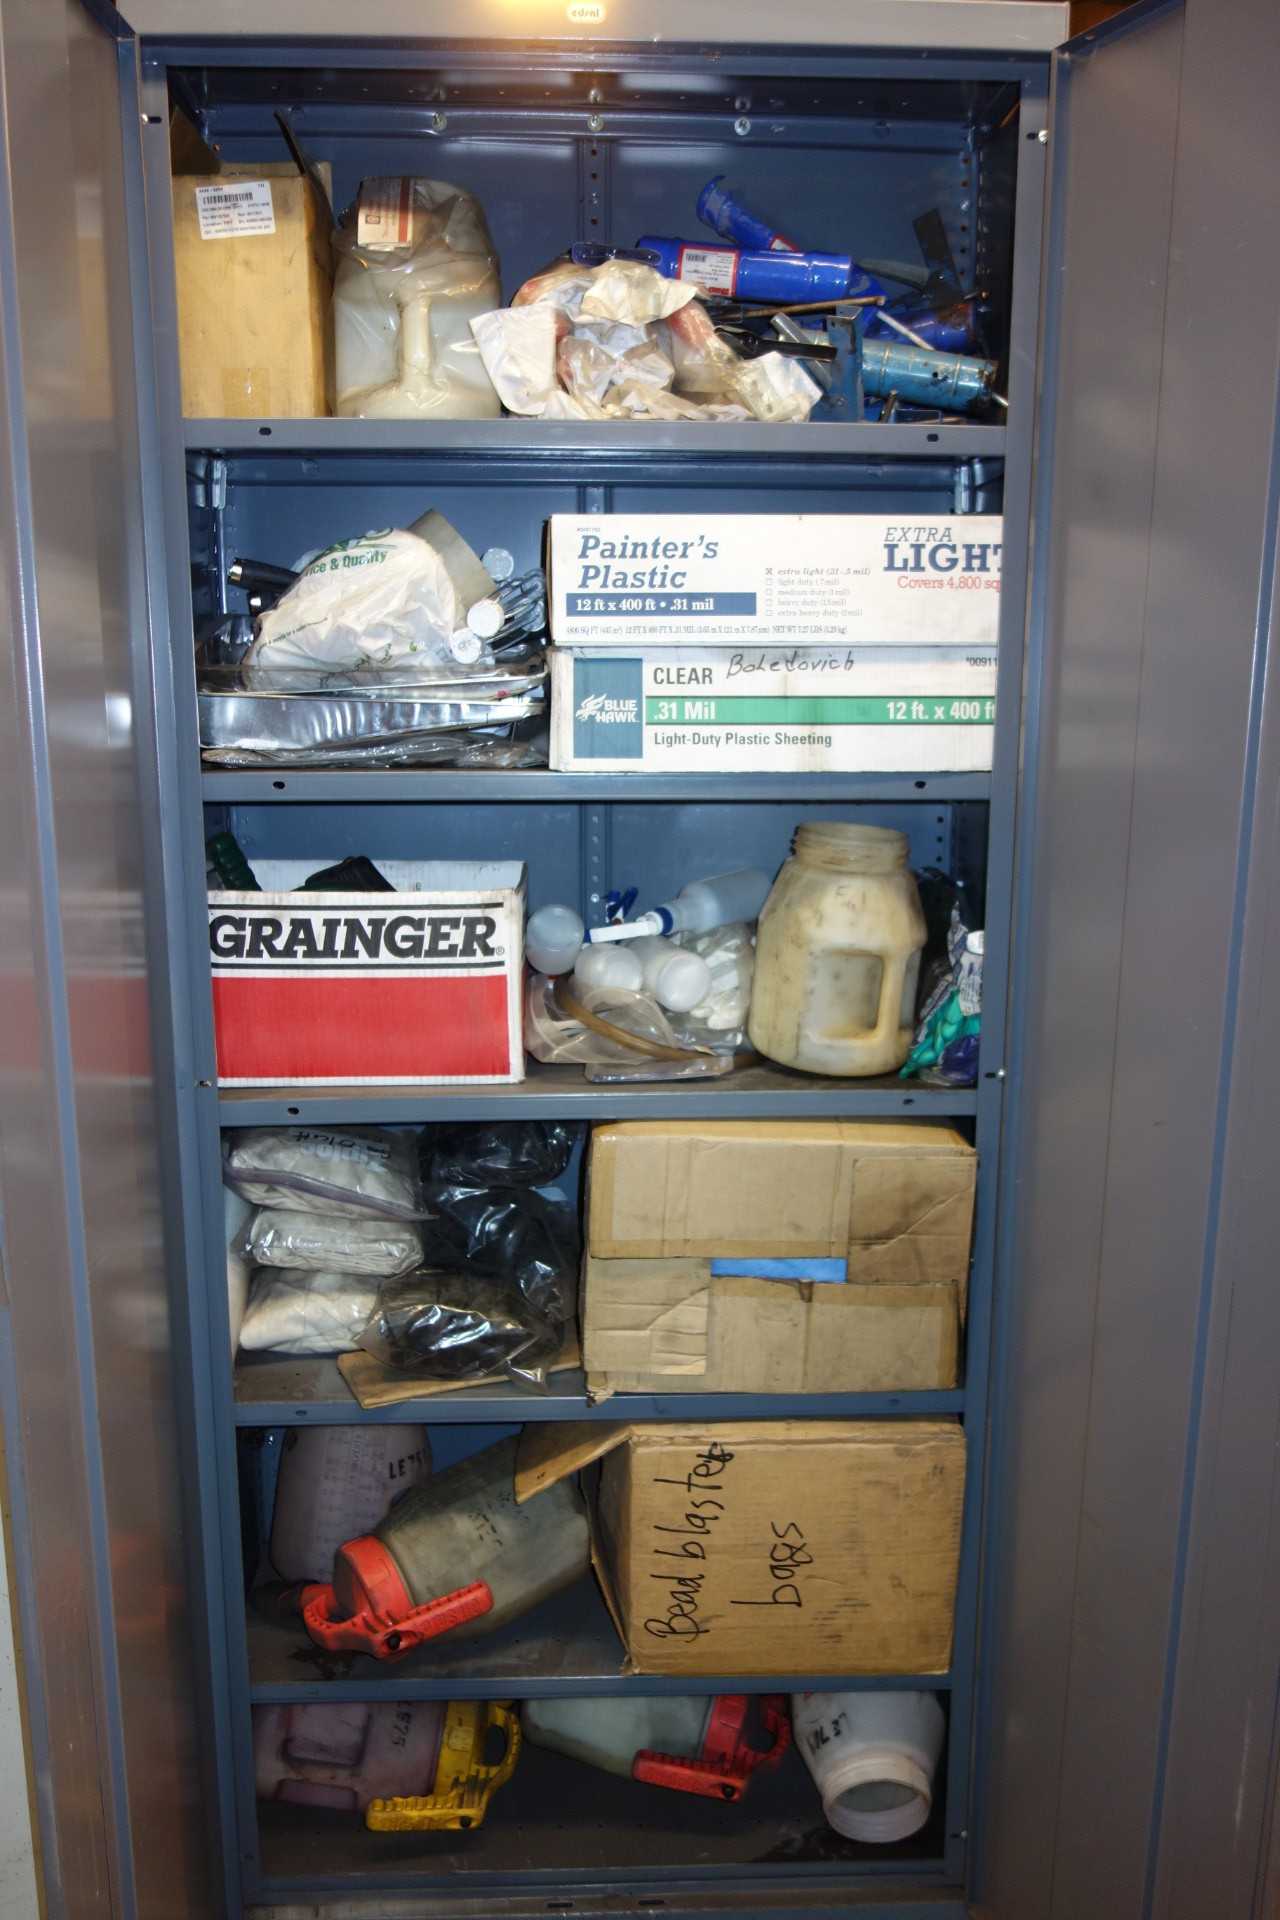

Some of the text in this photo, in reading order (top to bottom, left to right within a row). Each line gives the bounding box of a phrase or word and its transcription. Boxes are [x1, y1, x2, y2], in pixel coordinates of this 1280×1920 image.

[884, 527, 953, 542] EXTRA
[578, 534, 719, 559] Painter's
[330, 558, 340, 571] &
[578, 564, 687, 589] Plastic
[897, 575, 944, 589] Covers
[576, 598, 592, 611] 12
[594, 598, 605, 611] ft
[607, 602, 616, 611] x
[619, 598, 642, 611] 400
[644, 598, 656, 611] ft
[691, 598, 714, 611] mil
[653, 667, 713, 685] CLEAR
[604, 699, 638, 711] BLUE
[654, 701, 716, 720] .31 Mil
[887, 701, 907, 720] 12
[934, 705, 945, 720] x
[950, 701, 980, 720] 400
[595, 711, 637, 723] HAWK
[654, 732, 833, 748] Light-Duty Plastic Sheeting
[209, 914, 497, 958] GRAINGER
